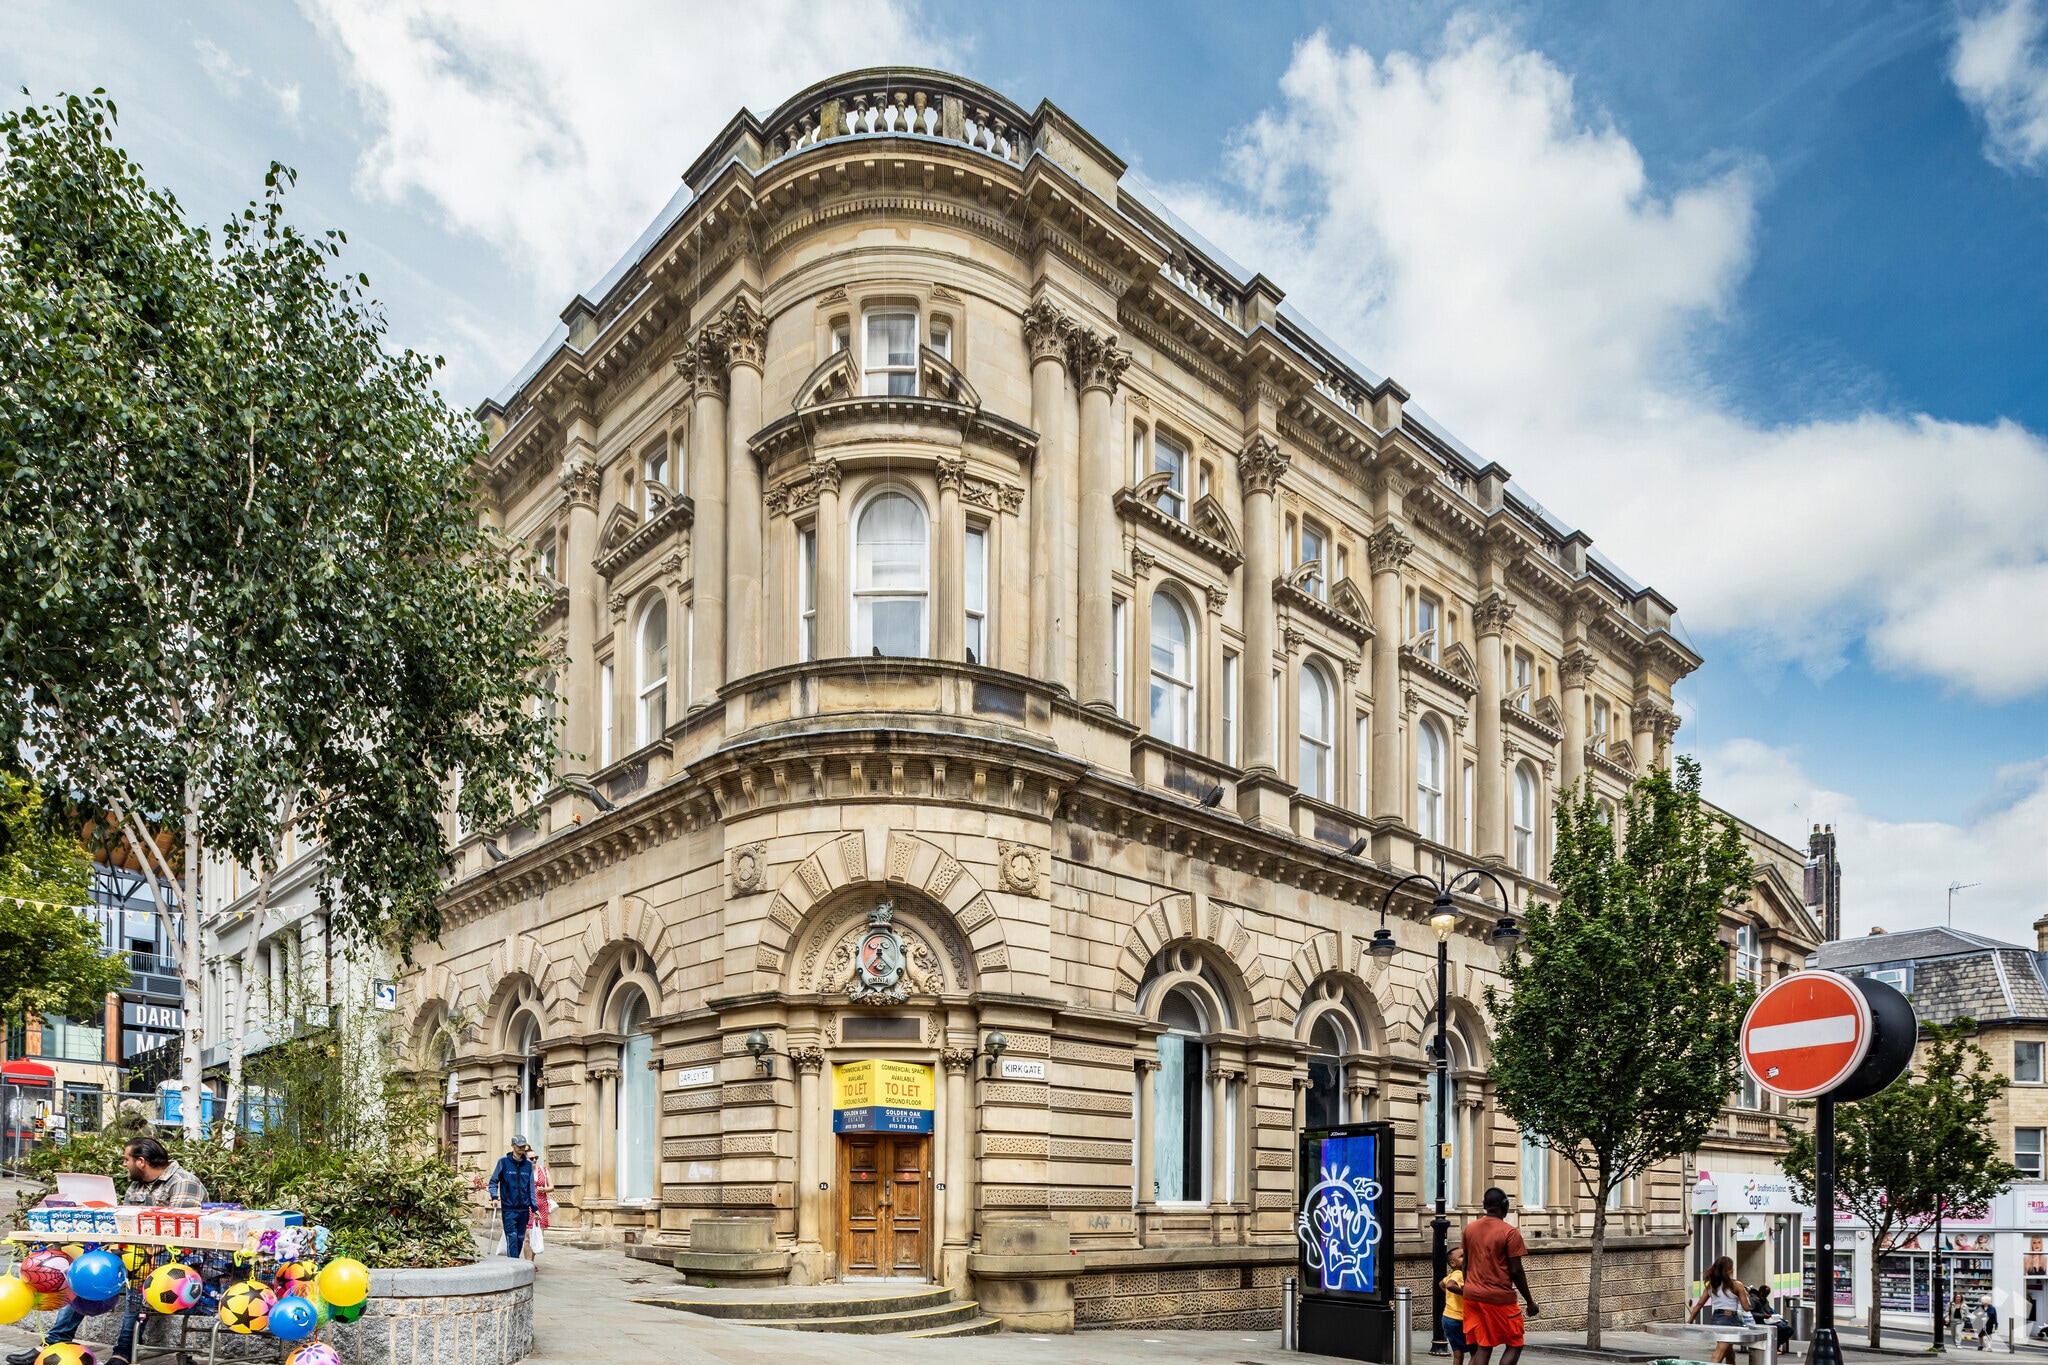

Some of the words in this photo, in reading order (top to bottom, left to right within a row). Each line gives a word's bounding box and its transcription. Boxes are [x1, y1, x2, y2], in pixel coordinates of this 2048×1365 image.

[868, 976, 889, 984] OMNIA
[881, 1064, 911, 1073] COMMERCIAL
[1005, 1063, 1042, 1075] KIRKGATE
[843, 1084, 853, 1097] TO
[855, 1082, 867, 1095] LET
[885, 1082, 898, 1095] TO
[902, 1084, 920, 1097] LET
[885, 1097, 905, 1105] GROUND
[1757, 1183, 1772, 1191] Bradford
[1775, 1184, 1787, 1192] District
[1749, 1195, 1762, 1210] age
[1762, 1195, 1770, 1206] UK
